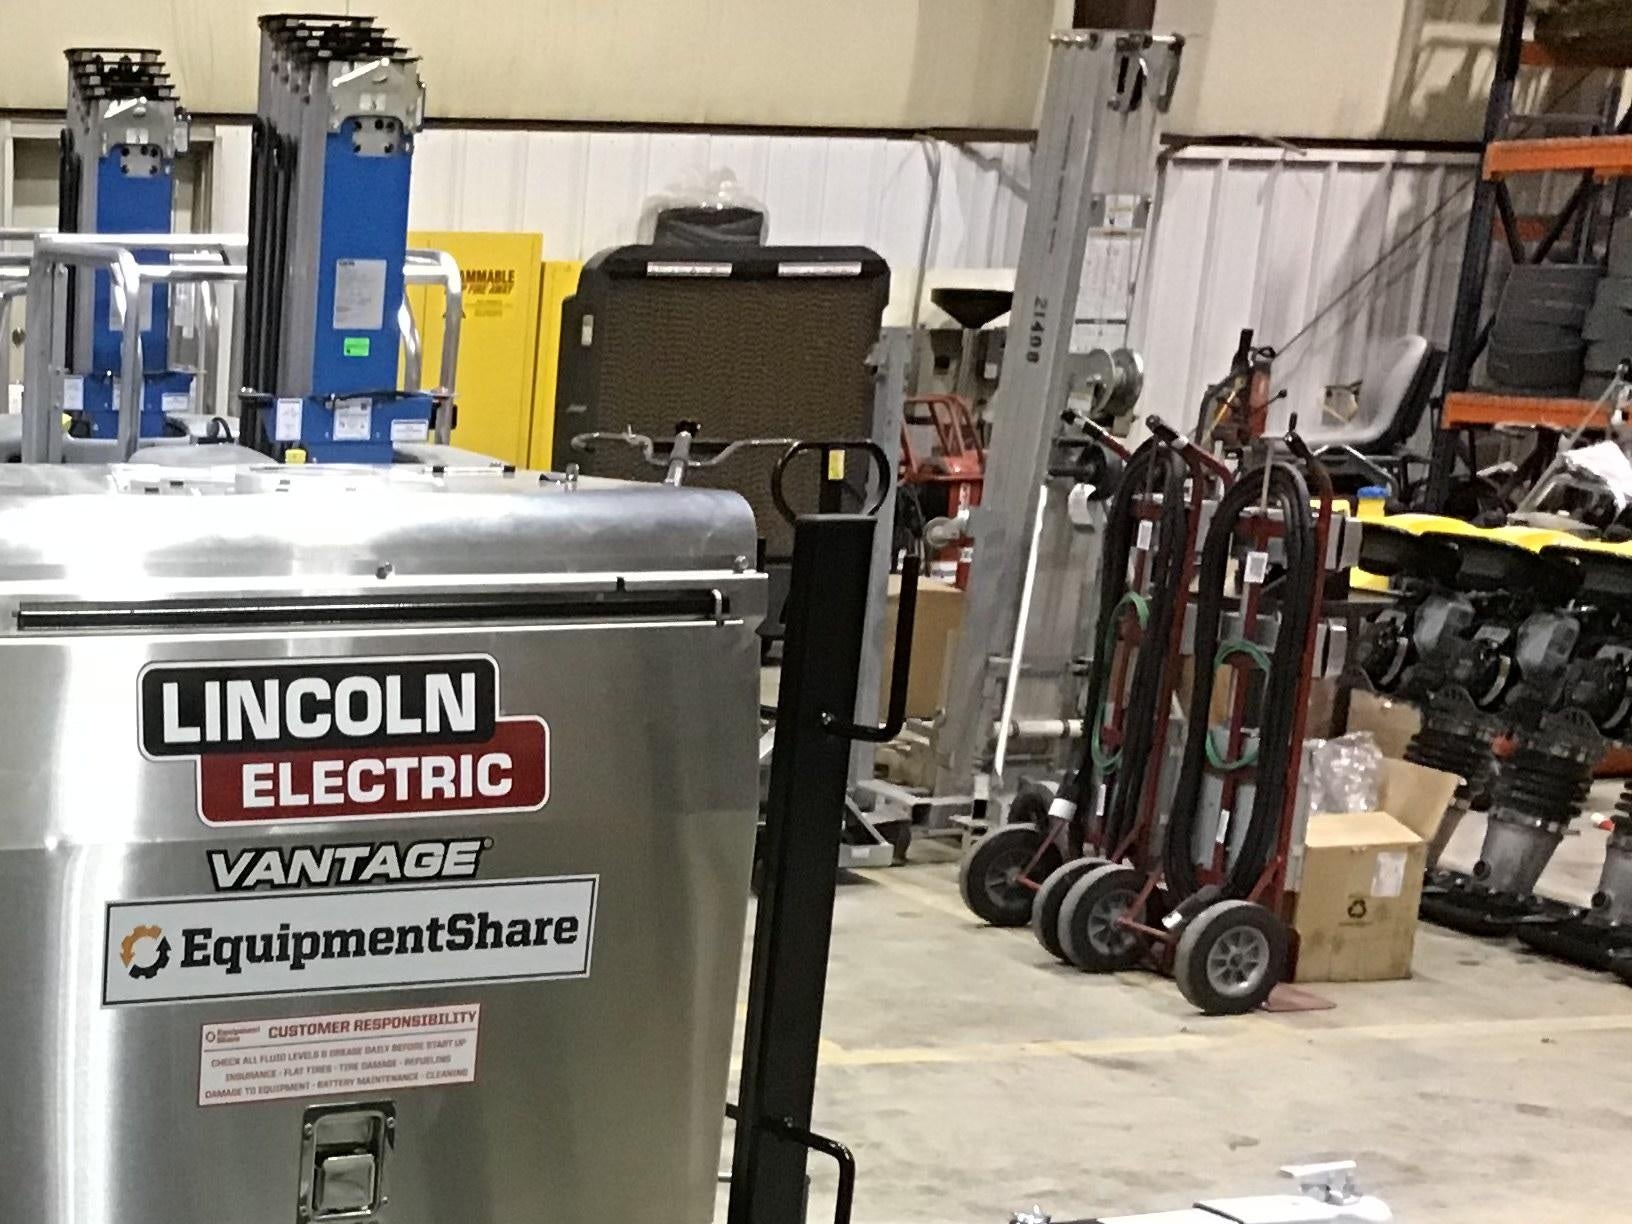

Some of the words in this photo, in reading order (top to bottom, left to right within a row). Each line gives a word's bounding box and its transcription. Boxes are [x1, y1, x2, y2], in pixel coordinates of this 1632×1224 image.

[459, 270, 515, 283] AMMABLE
[163, 672, 476, 744] LINCOLN
[242, 752, 513, 809] ELECTRIC
[210, 840, 484, 889] VANTAGE
[180, 911, 579, 975] EquipmentShare
[268, 1020, 351, 1039] CUSTOMER
[353, 1010, 477, 1032] RESPONSIBILITY
[211, 1057, 240, 1068] CHECK
[242, 1056, 257, 1065] ALL
[259, 1053, 287, 1063] FLUID
[288, 1050, 320, 1061] LEVELS
[364, 1043, 390, 1054] DAILY
[391, 1041, 424, 1052] BEFORE
[426, 1039, 453, 1049] START
[454, 1038, 467, 1047] UP
[245, 1086, 257, 1096] TO
[356, 1072, 419, 1086] MAINTENANCE
[283, 1067, 304, 1077] FLAT
